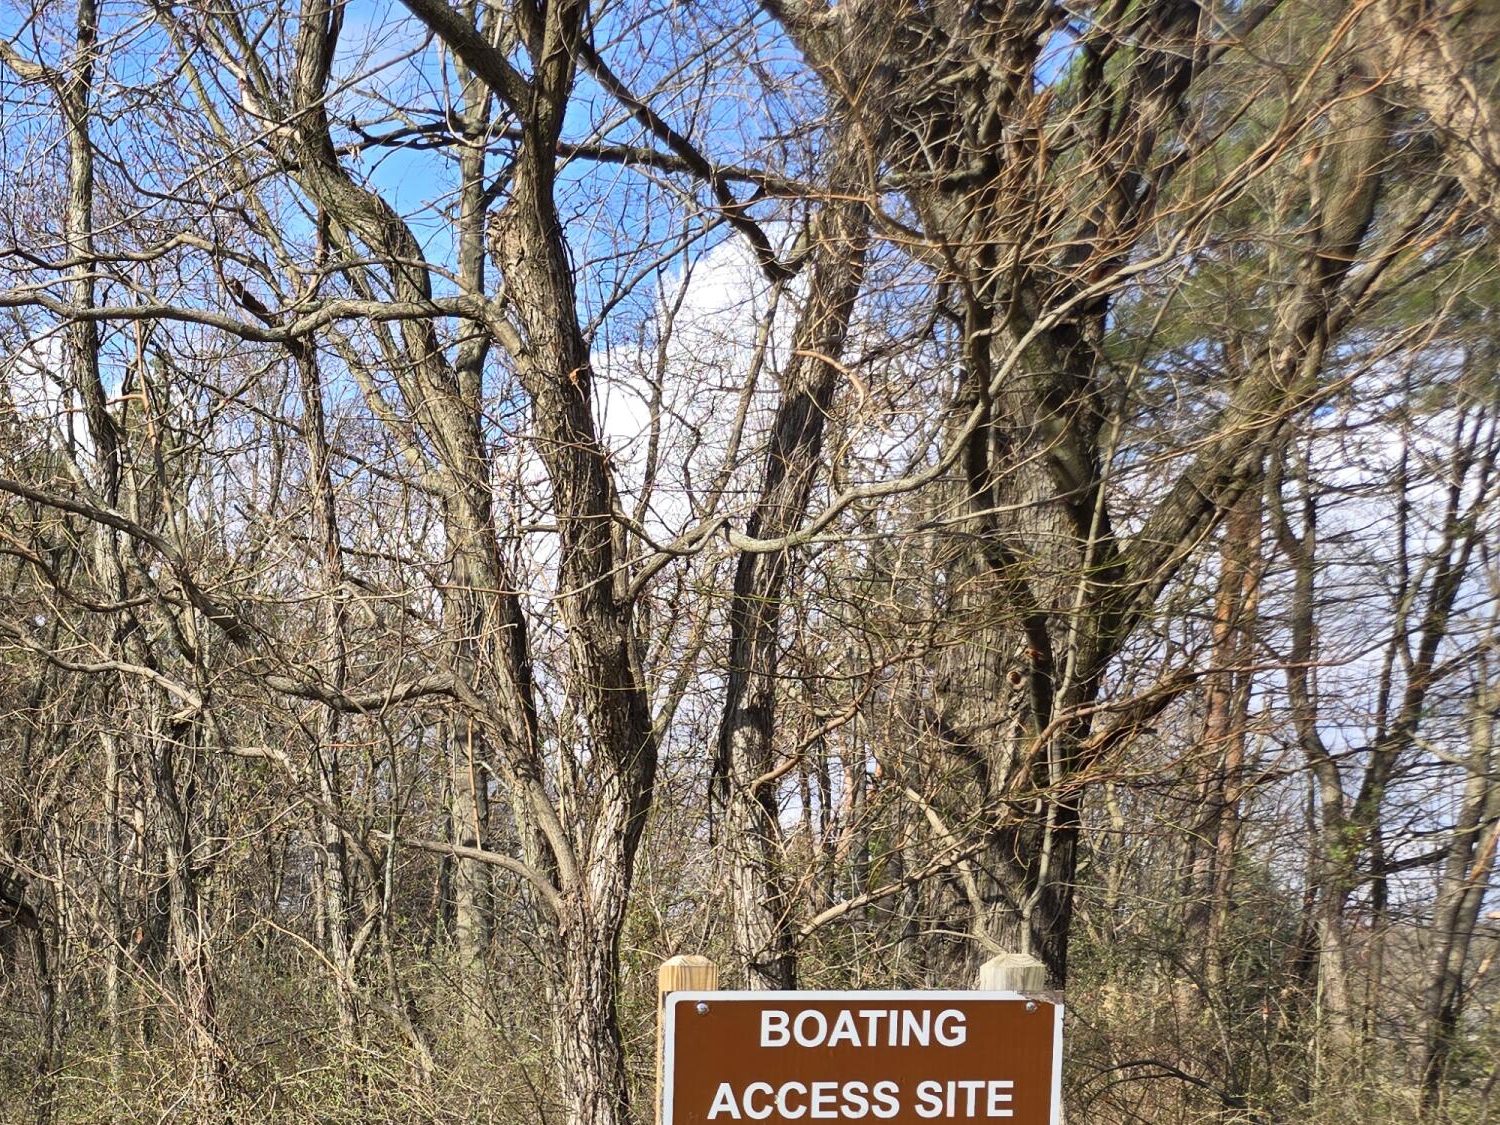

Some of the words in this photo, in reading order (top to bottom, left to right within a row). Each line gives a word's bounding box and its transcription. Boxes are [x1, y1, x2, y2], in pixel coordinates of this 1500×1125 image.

[760, 1009, 967, 1048] BOATING
[706, 1080, 900, 1120] ACCESS
[914, 1080, 1014, 1119] SITE
